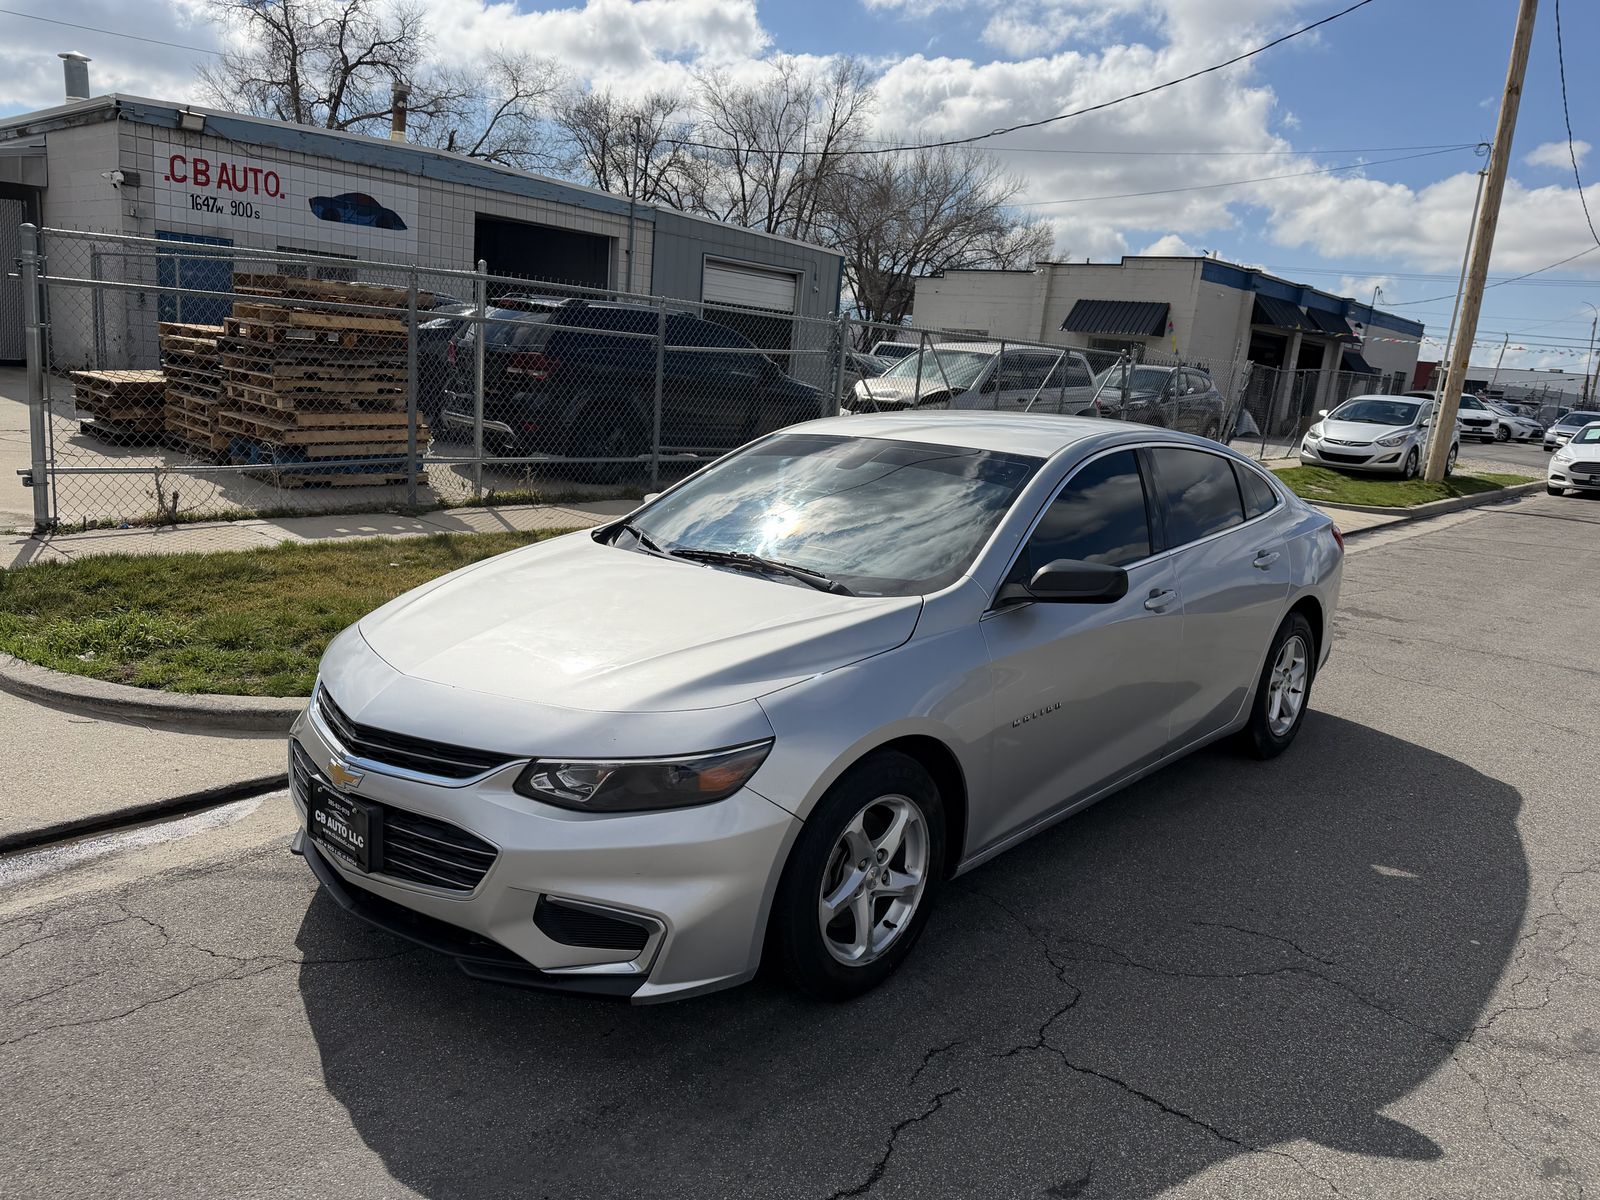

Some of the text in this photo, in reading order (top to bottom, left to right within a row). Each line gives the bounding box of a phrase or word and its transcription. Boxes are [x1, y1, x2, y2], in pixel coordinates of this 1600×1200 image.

[315, 810, 326, 825] CB
[327, 816, 348, 838] AUTO
[349, 830, 364, 848] LLC
